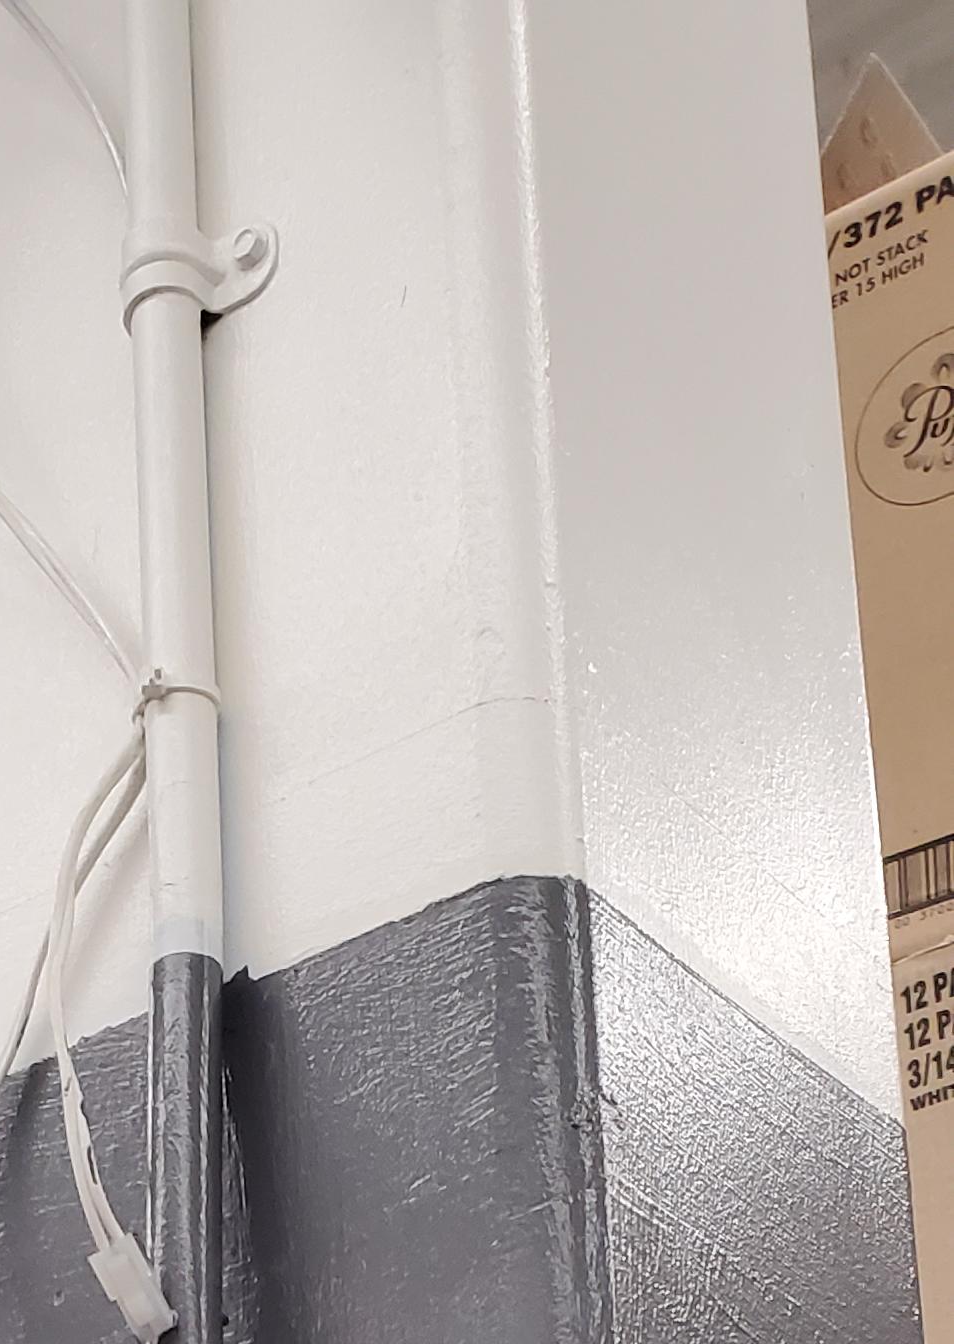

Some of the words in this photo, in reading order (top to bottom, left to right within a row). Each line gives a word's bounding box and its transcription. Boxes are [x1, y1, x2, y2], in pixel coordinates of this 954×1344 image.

[834, 258, 871, 286] NOT
[876, 229, 928, 266] STACK
[855, 277, 876, 296] 15
[881, 252, 925, 285] HIGH
[900, 980, 928, 1014] 12
[904, 1016, 930, 1050] 12
